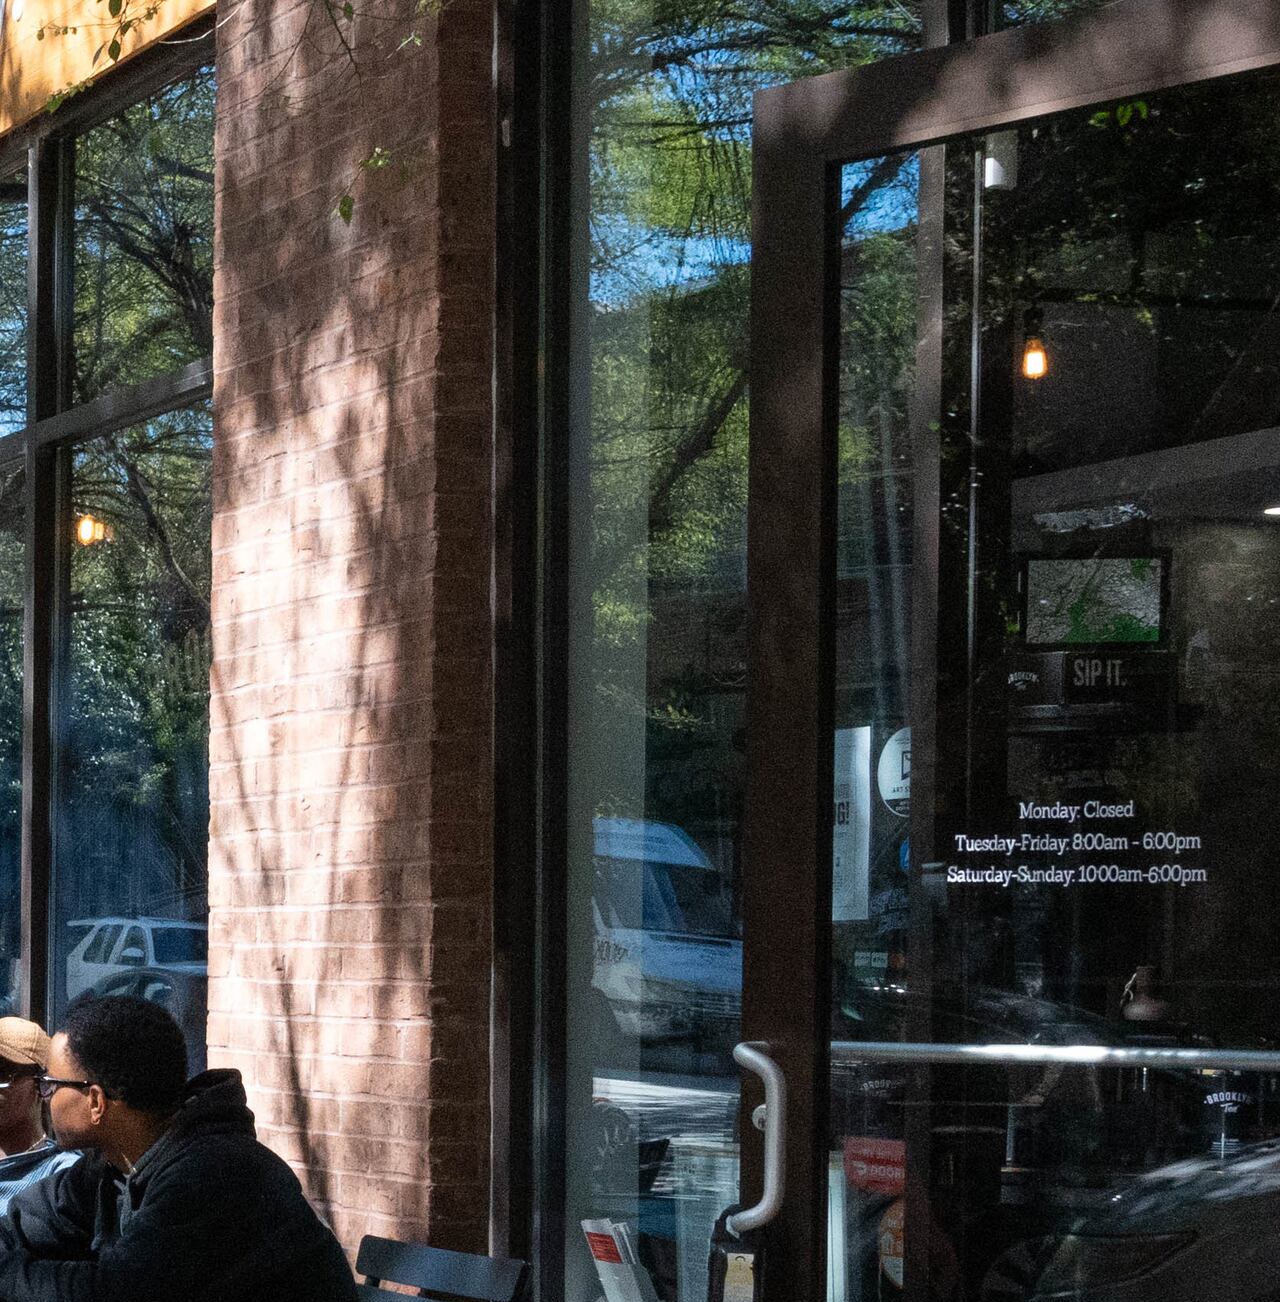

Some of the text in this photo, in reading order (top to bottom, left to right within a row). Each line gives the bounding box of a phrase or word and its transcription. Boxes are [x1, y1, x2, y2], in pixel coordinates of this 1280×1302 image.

[1073, 659, 1101, 686] SIP
[1083, 800, 1134, 818] Closed
[1072, 833, 1128, 851] 8:00am
[1143, 832, 1201, 854] 6:00pm
